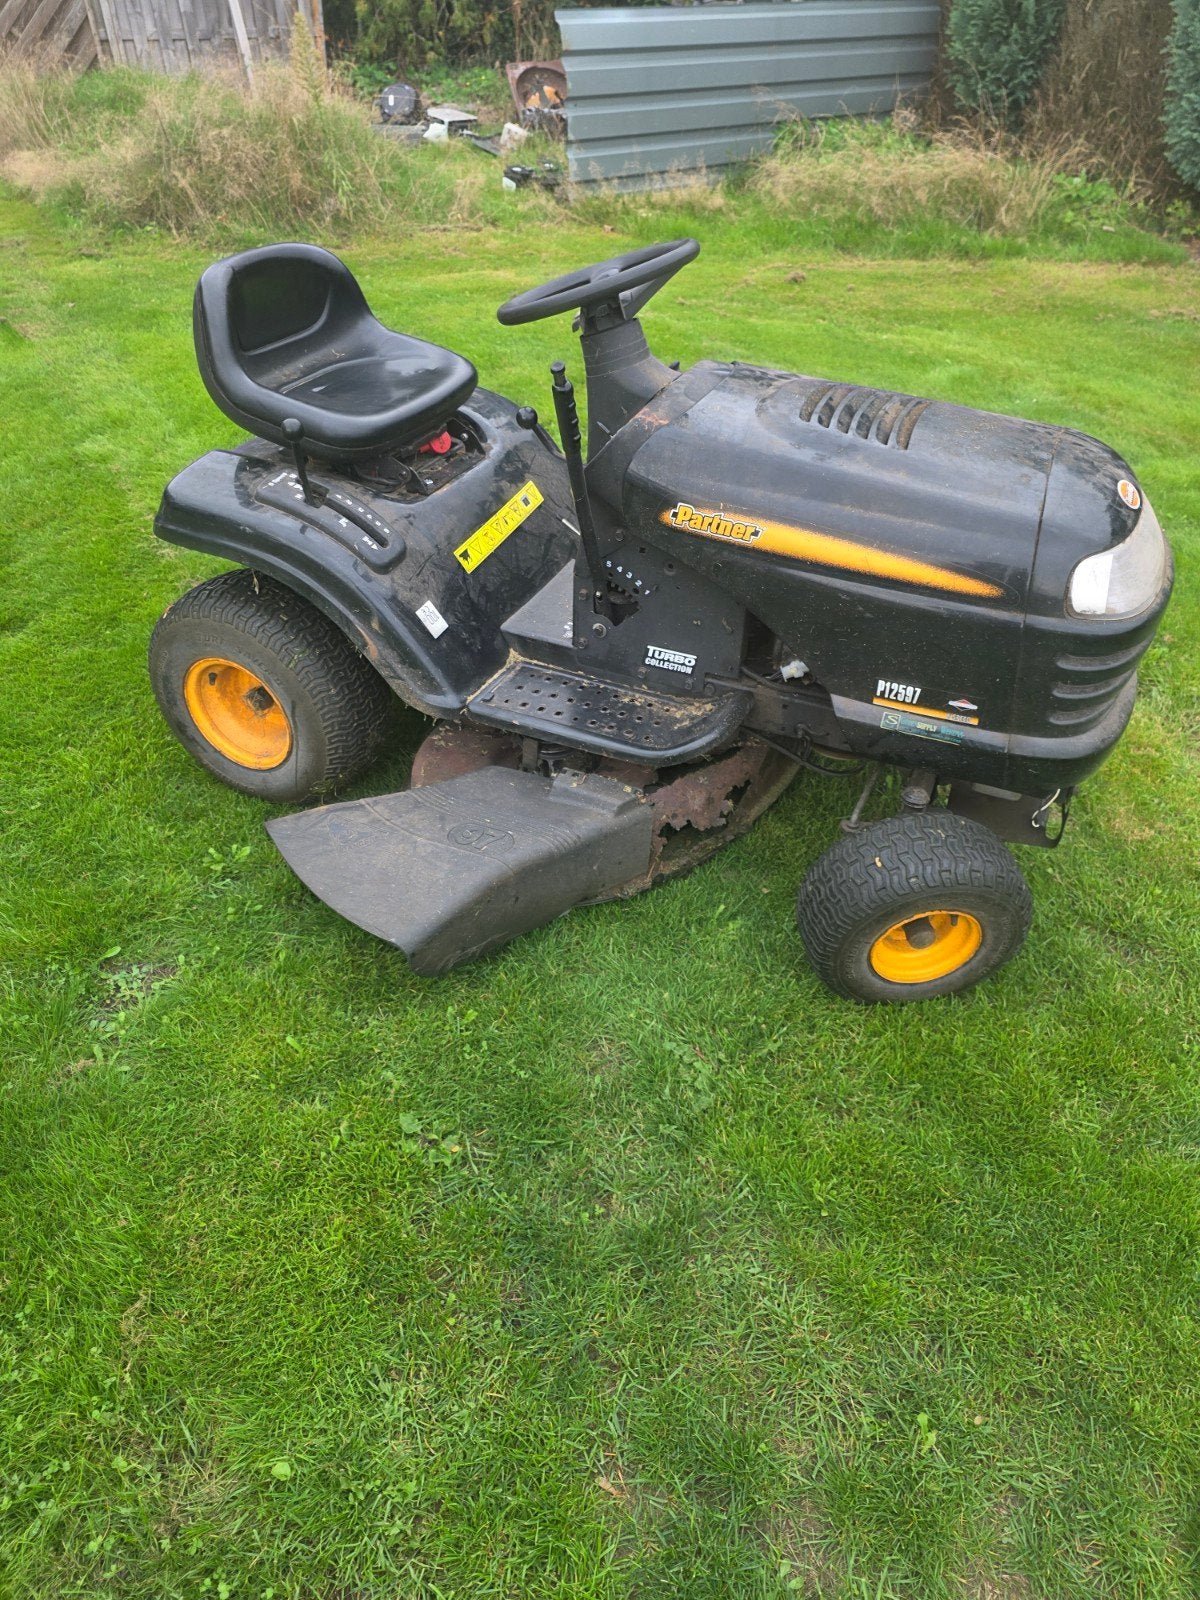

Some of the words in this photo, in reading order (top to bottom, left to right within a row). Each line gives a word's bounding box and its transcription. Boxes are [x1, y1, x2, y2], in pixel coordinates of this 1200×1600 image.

[675, 505, 757, 541] Partner
[606, 560, 612, 568] 5
[625, 571, 633, 579] 3
[634, 579, 643, 587] 2
[644, 657, 693, 675] COLLECTION
[876, 679, 922, 705] P12597
